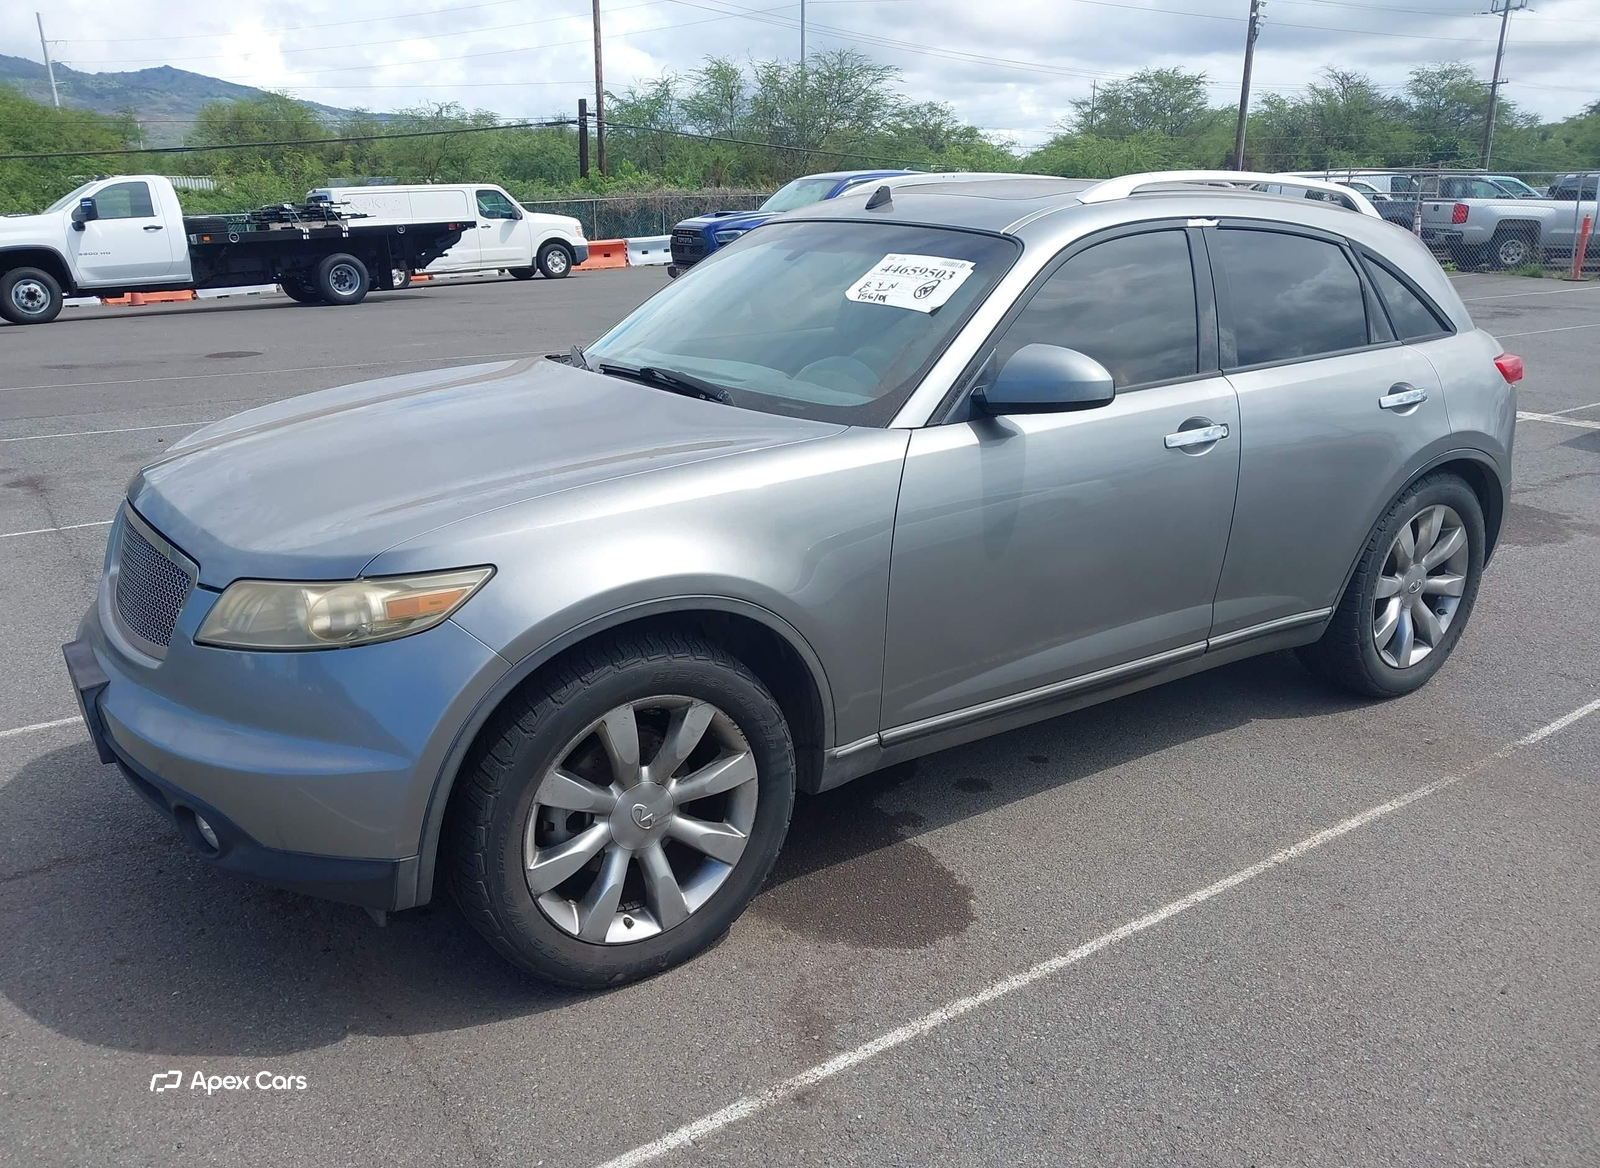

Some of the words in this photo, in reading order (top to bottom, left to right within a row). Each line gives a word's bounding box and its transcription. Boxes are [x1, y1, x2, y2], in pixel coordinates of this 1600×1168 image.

[880, 263, 956, 281] 44659503
[651, 669, 778, 749] BFGoodrich
[501, 887, 528, 935] T/A
